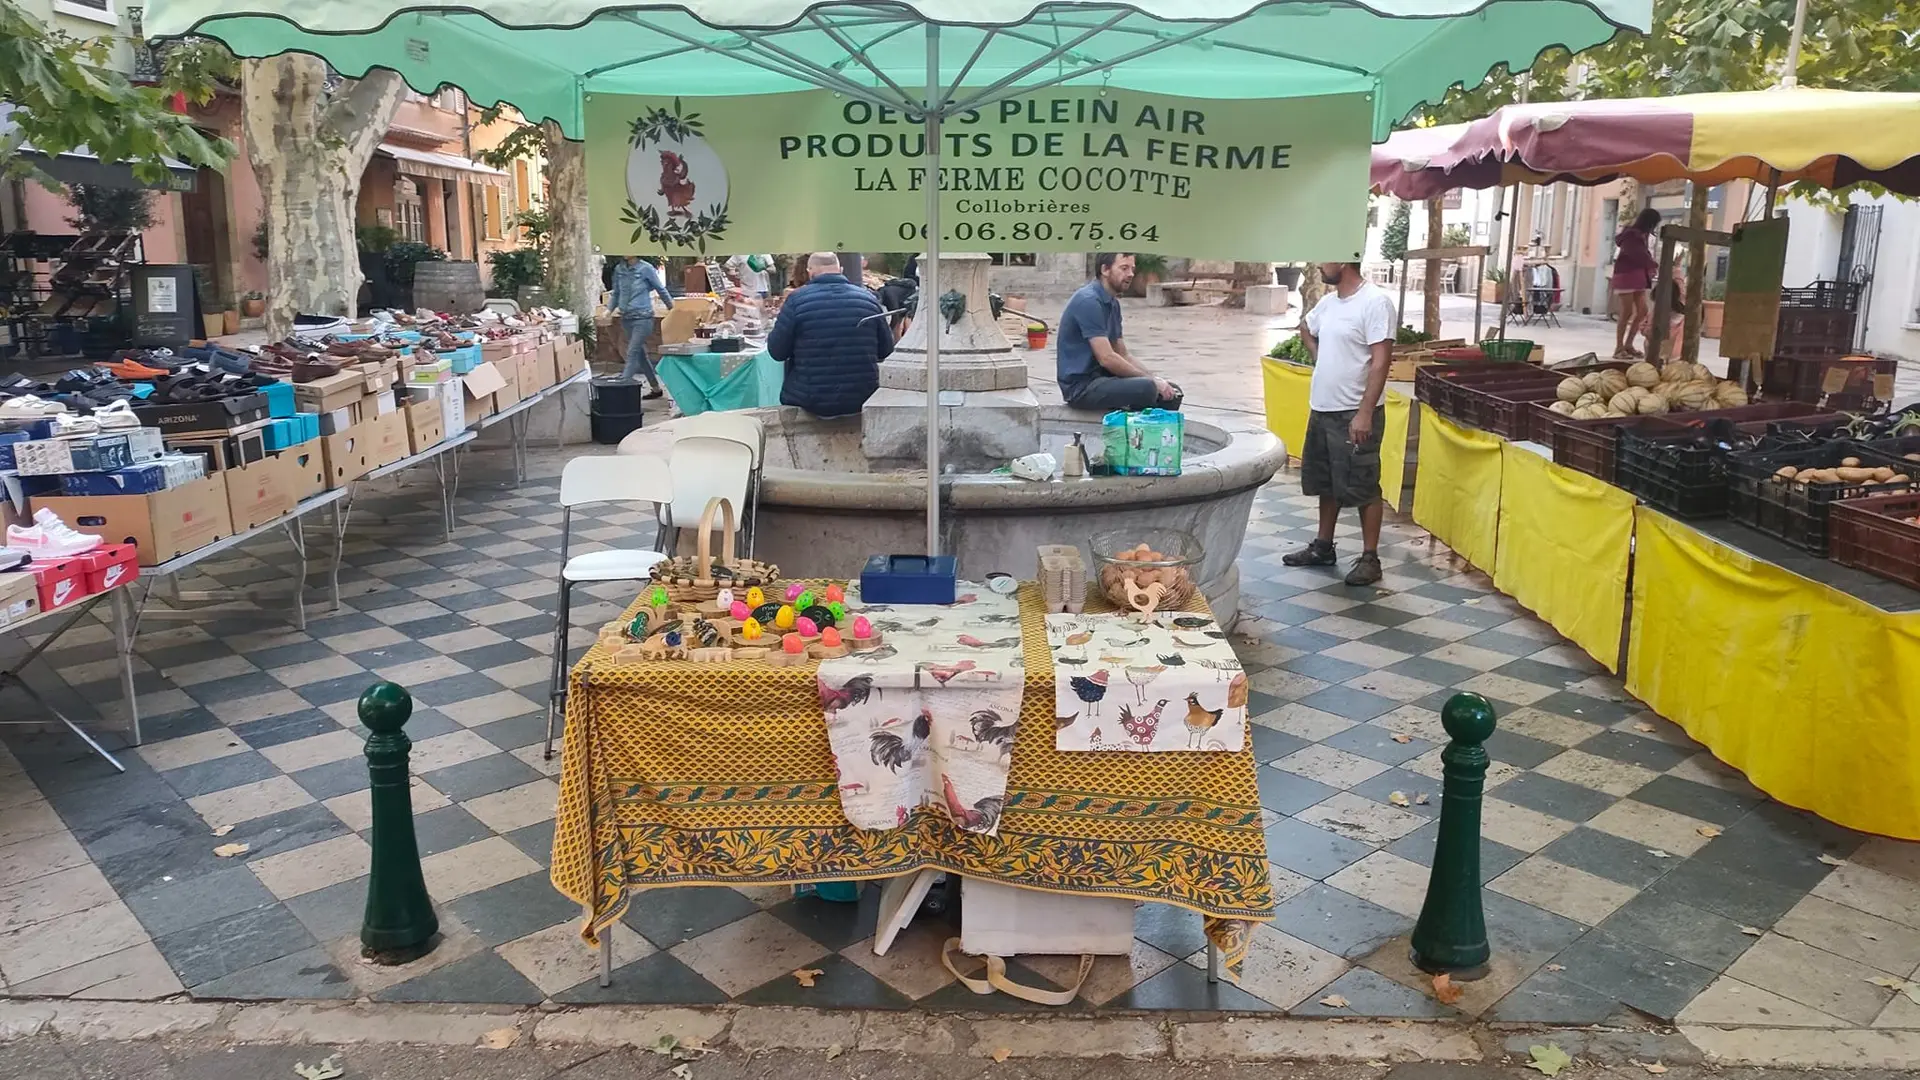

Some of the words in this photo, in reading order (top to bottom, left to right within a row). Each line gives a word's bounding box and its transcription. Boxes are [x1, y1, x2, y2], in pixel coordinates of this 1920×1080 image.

[1000, 98, 1119, 124] PLEIN
[1135, 104, 1205, 136] AIR
[780, 133, 993, 160] PRODUTS
[1012, 132, 1064, 157] DE
[1084, 133, 1128, 157] LA
[1146, 138, 1293, 170] FERME
[855, 167, 898, 192] LA
[1039, 166, 1191, 200] COCOTTE
[956, 199, 1090, 214] Collobrières
[157, 414, 199, 425] ARIZONA
